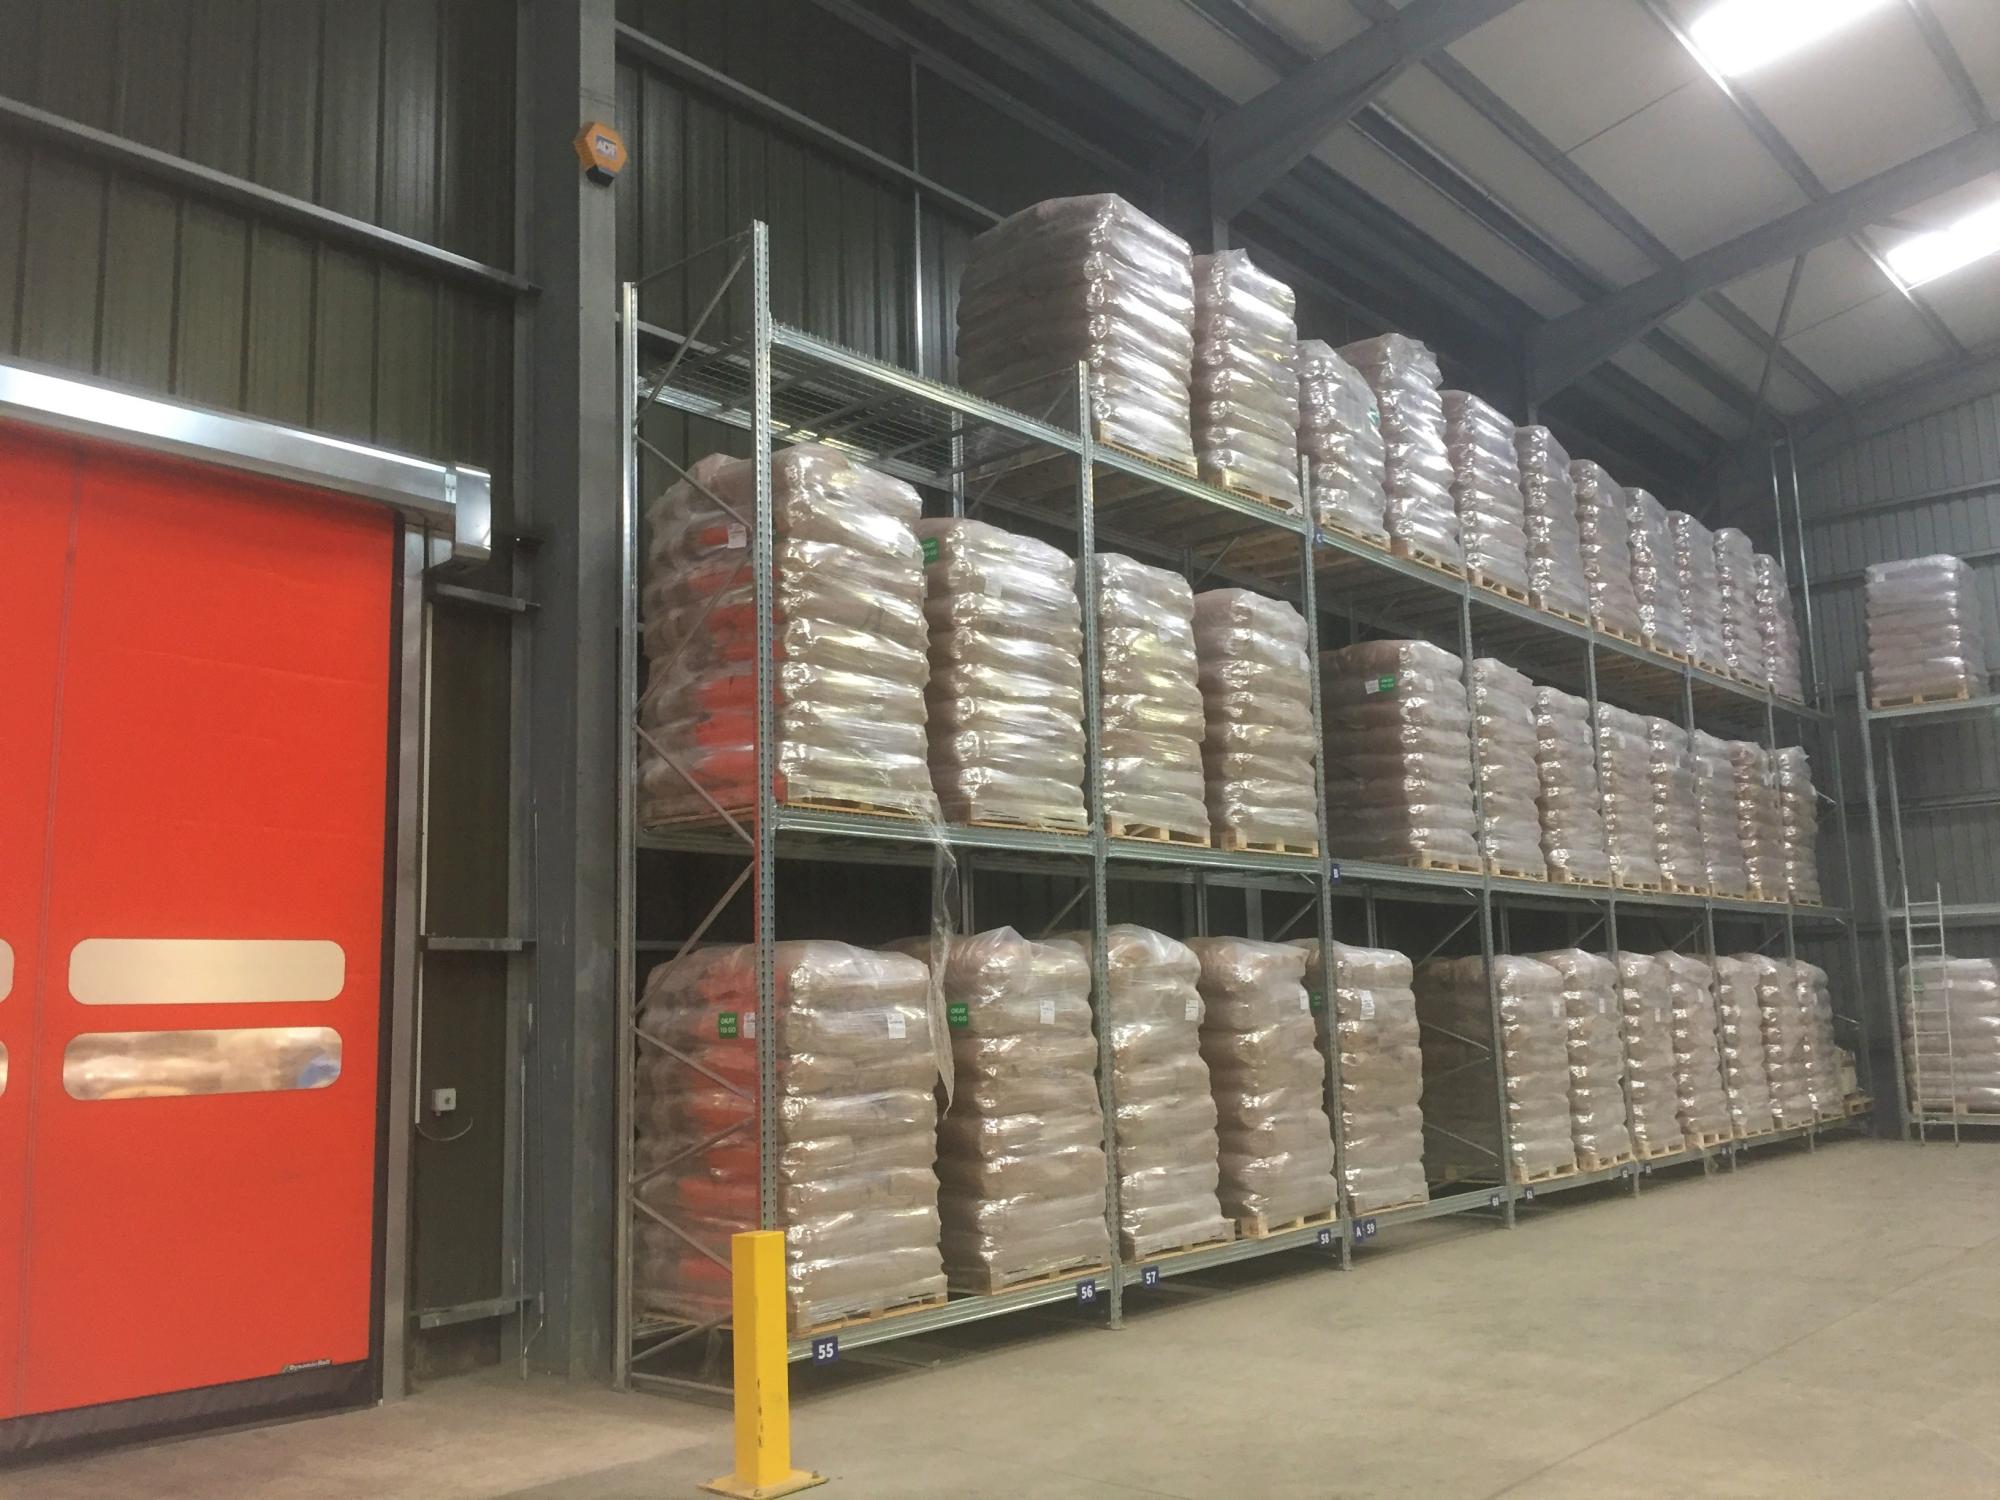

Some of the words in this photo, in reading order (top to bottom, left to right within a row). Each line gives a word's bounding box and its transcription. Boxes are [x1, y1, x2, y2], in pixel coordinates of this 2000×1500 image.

[596, 139, 617, 160] ADT
[720, 1017, 735, 1025] OKAY
[1356, 1226, 1361, 1237] A
[1366, 1223, 1375, 1234] 59
[1320, 1232, 1330, 1245] 58
[1145, 1271, 1156, 1284] 57
[1081, 1285, 1093, 1299] 56
[818, 1342, 834, 1360] 55
